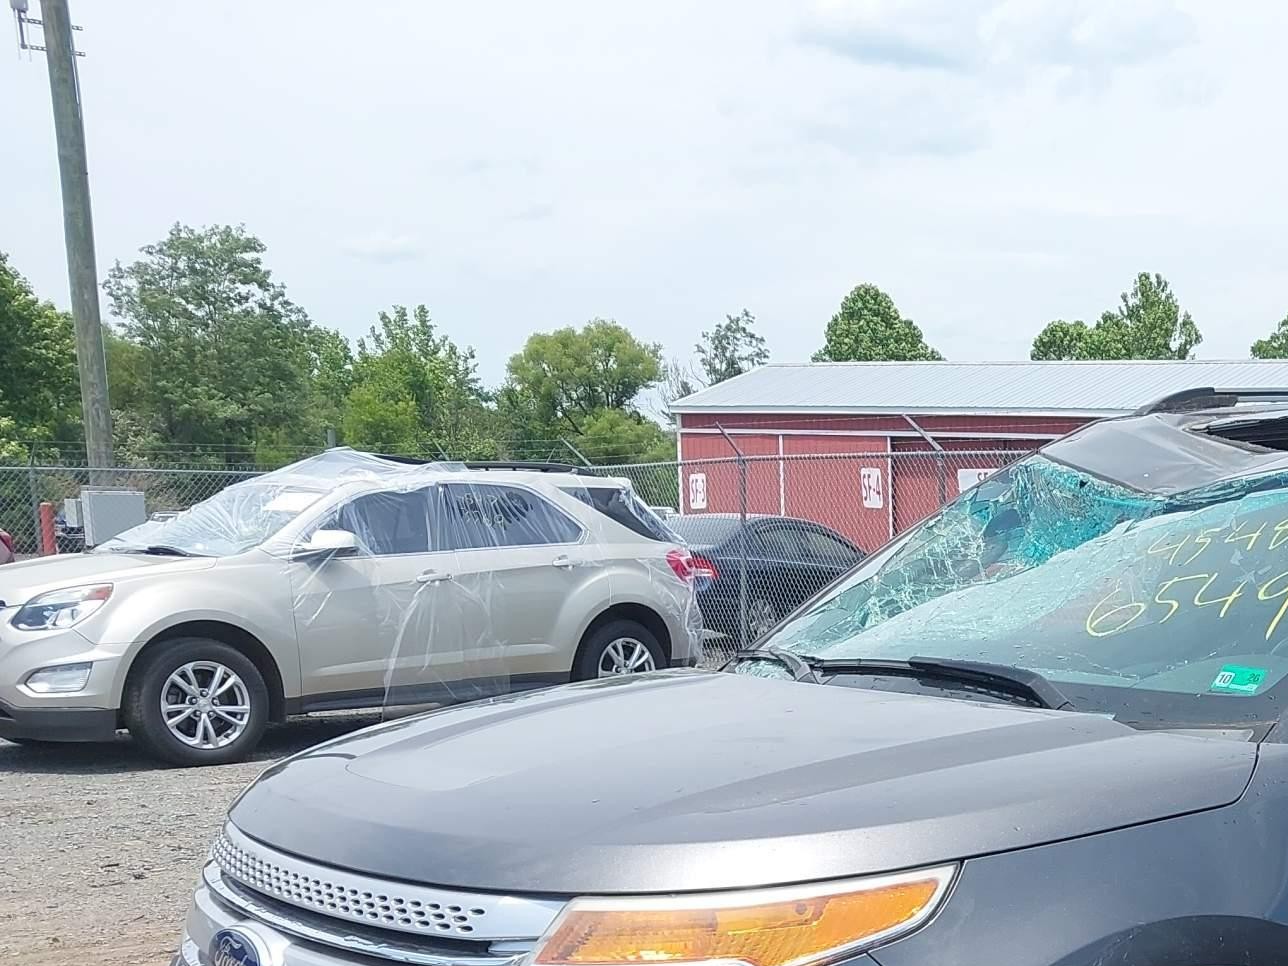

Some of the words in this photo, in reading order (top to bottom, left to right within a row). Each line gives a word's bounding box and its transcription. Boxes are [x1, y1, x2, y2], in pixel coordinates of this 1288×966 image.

[690, 478, 706, 503] SF-3
[862, 473, 882, 502] SF-4
[1218, 673, 1232, 688] 10
